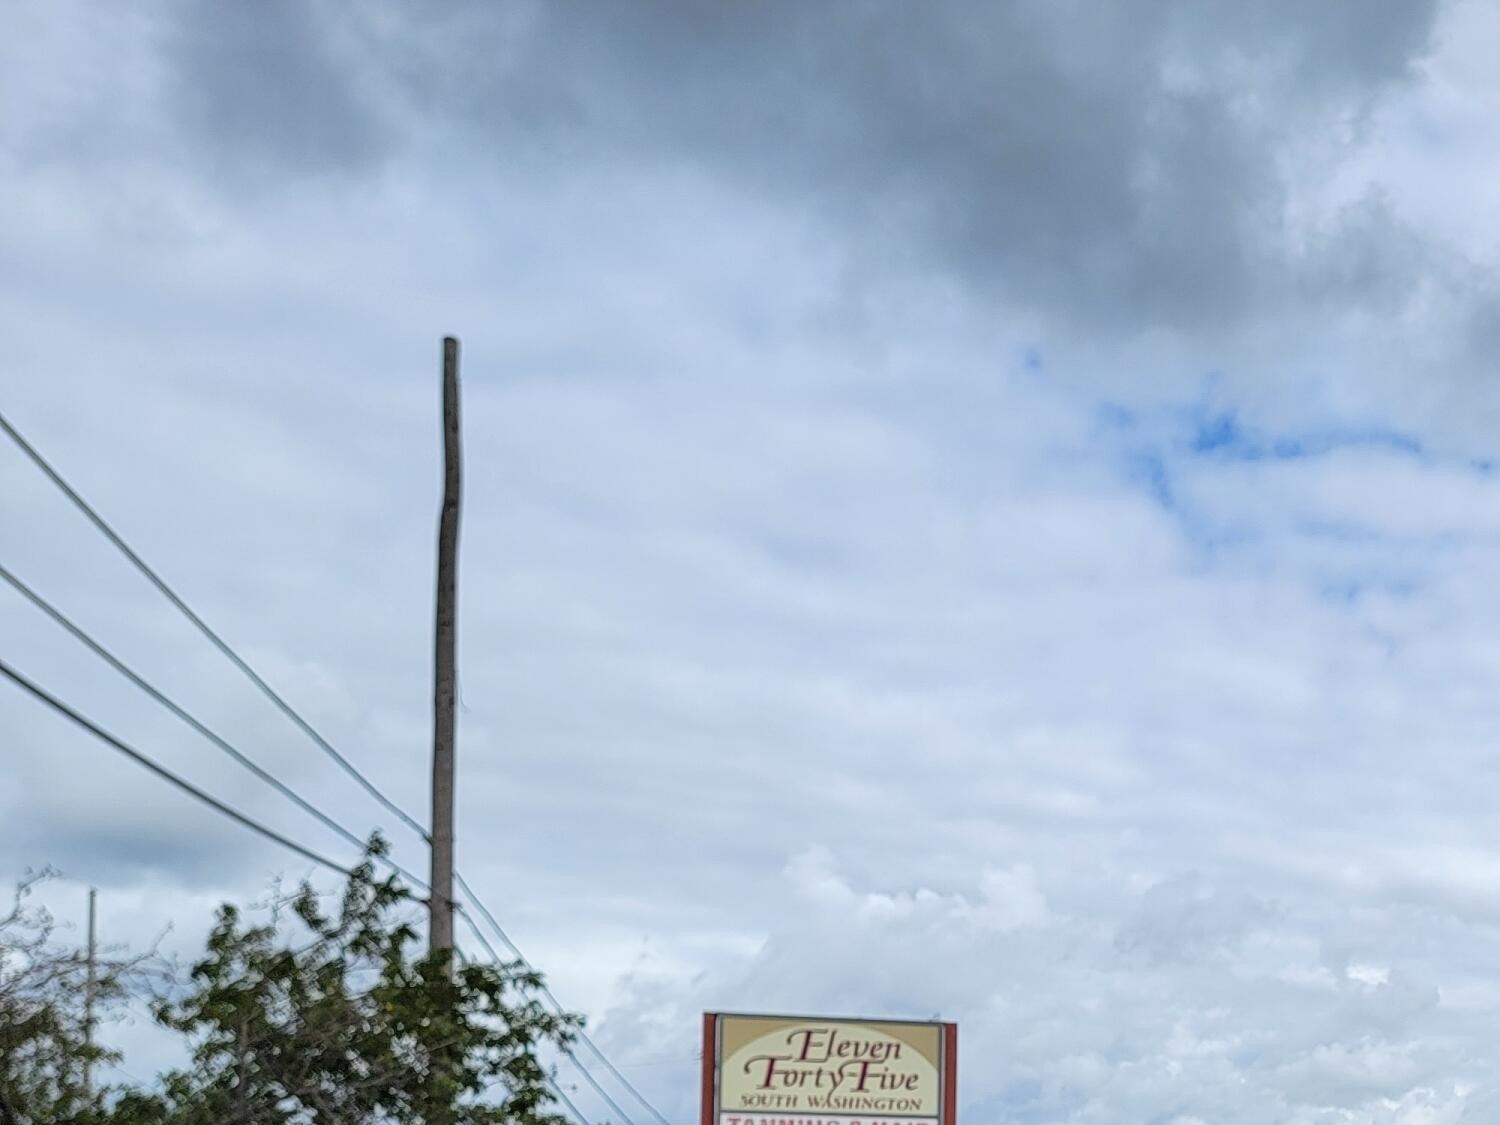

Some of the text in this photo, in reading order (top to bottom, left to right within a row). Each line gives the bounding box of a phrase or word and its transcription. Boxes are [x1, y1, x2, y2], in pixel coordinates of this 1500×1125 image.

[787, 1029, 902, 1063] Eleven
[741, 1093, 922, 1111] SOUTH WASHINGTON
